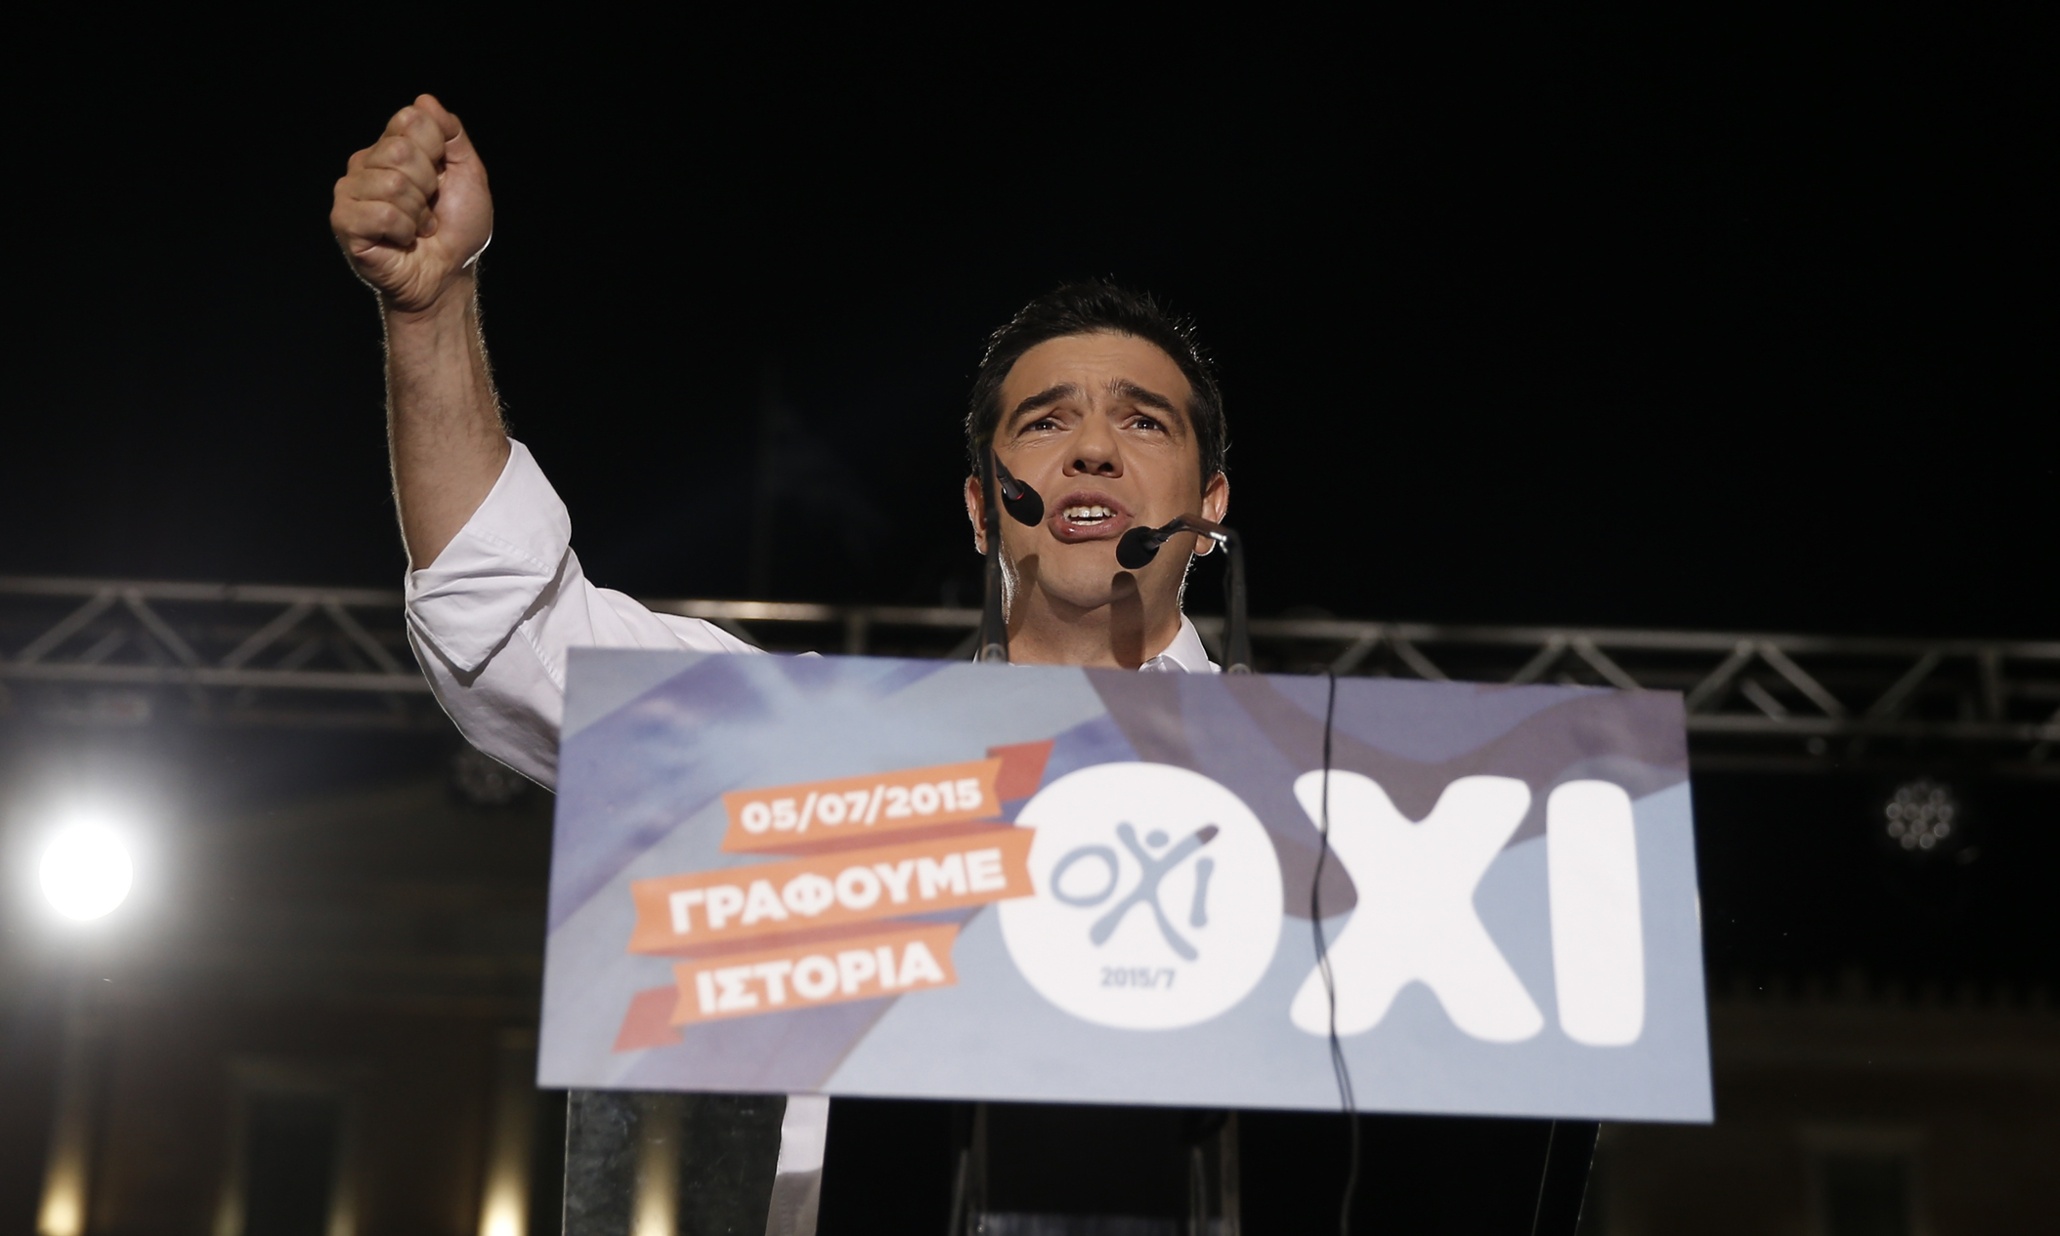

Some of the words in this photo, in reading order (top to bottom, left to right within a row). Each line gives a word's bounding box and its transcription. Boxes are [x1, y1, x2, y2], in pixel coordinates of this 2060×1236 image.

[740, 778, 983, 834] 05/07/2015
[668, 848, 1007, 934] ΓΡΑΦΟΥΜΕ
[696, 942, 945, 1014] ΙΣΤΟΡΙΑ
[1099, 966, 1176, 988] 2015/7
